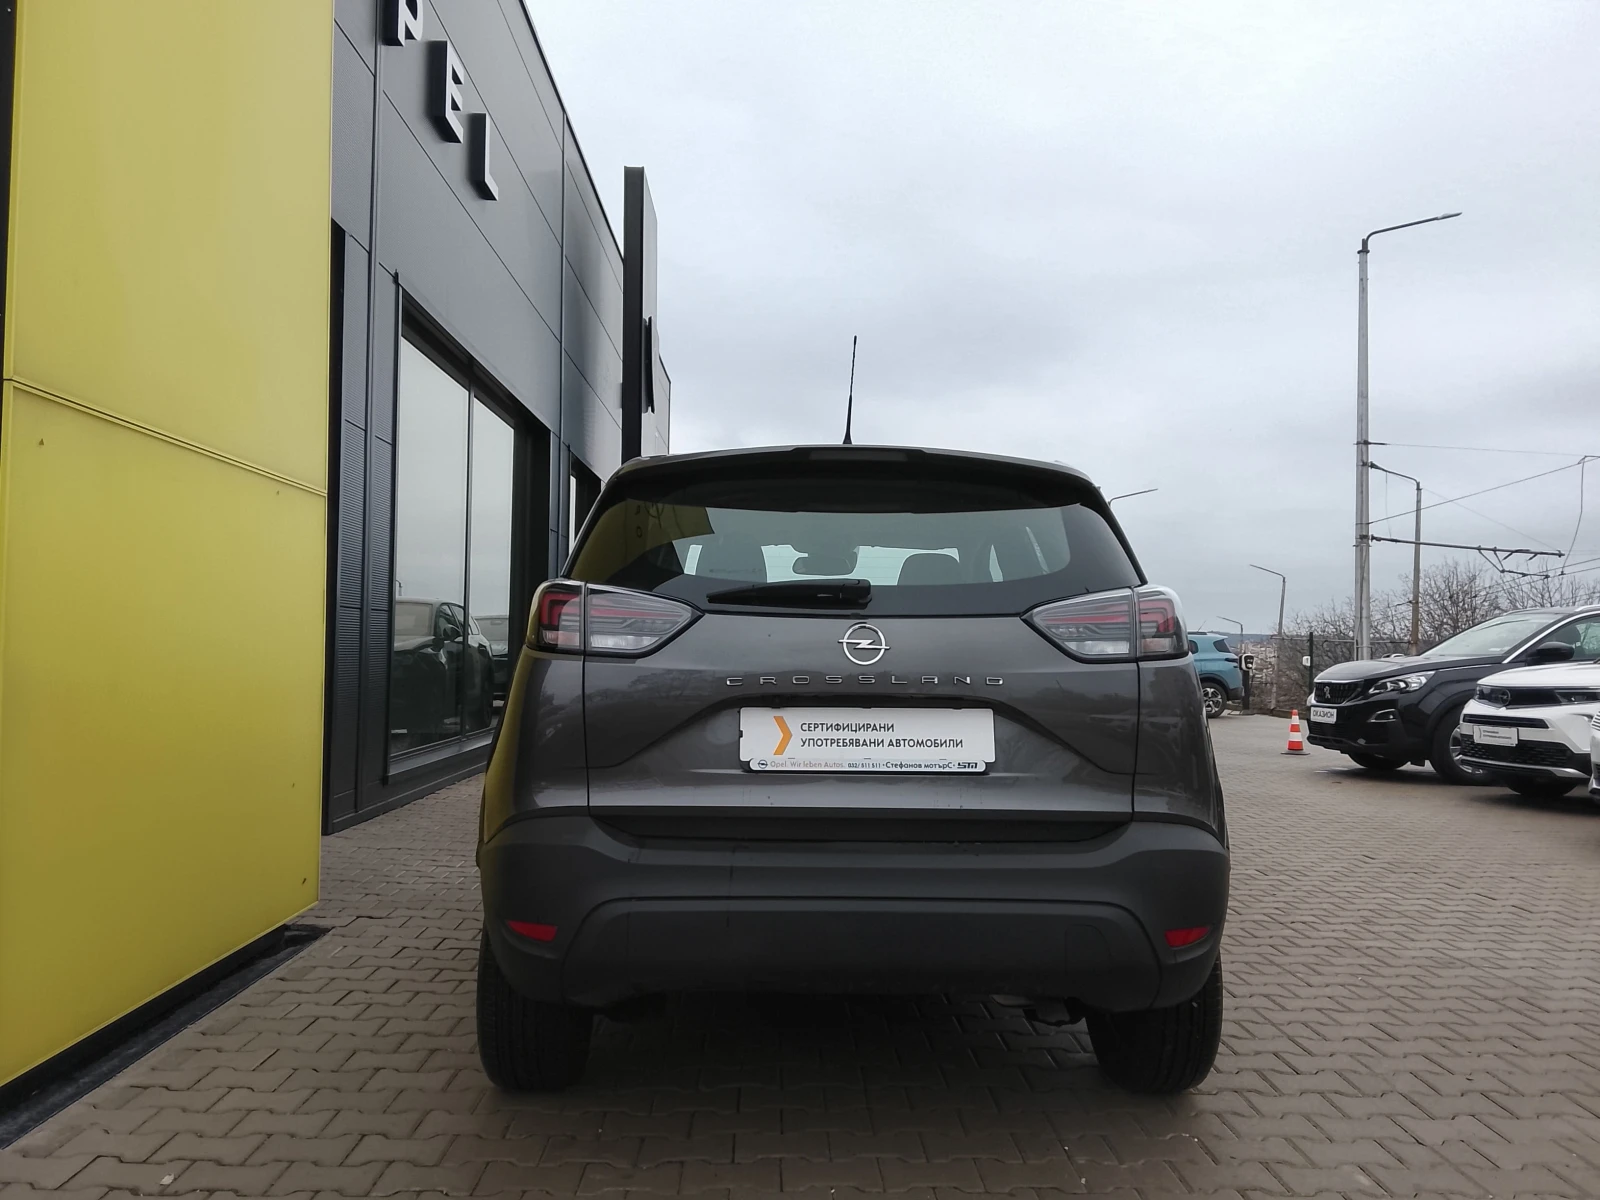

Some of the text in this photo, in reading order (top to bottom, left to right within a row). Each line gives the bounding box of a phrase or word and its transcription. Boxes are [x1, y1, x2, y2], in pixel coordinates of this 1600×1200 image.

[726, 675, 1004, 686] CROSSLAND
[800, 722, 895, 733] СЕРТИФИЦИРАНИ
[800, 738, 964, 748] УПОТРЕБЯВАНИ АВТОМОБИЛИ
[803, 760, 822, 768] leben
